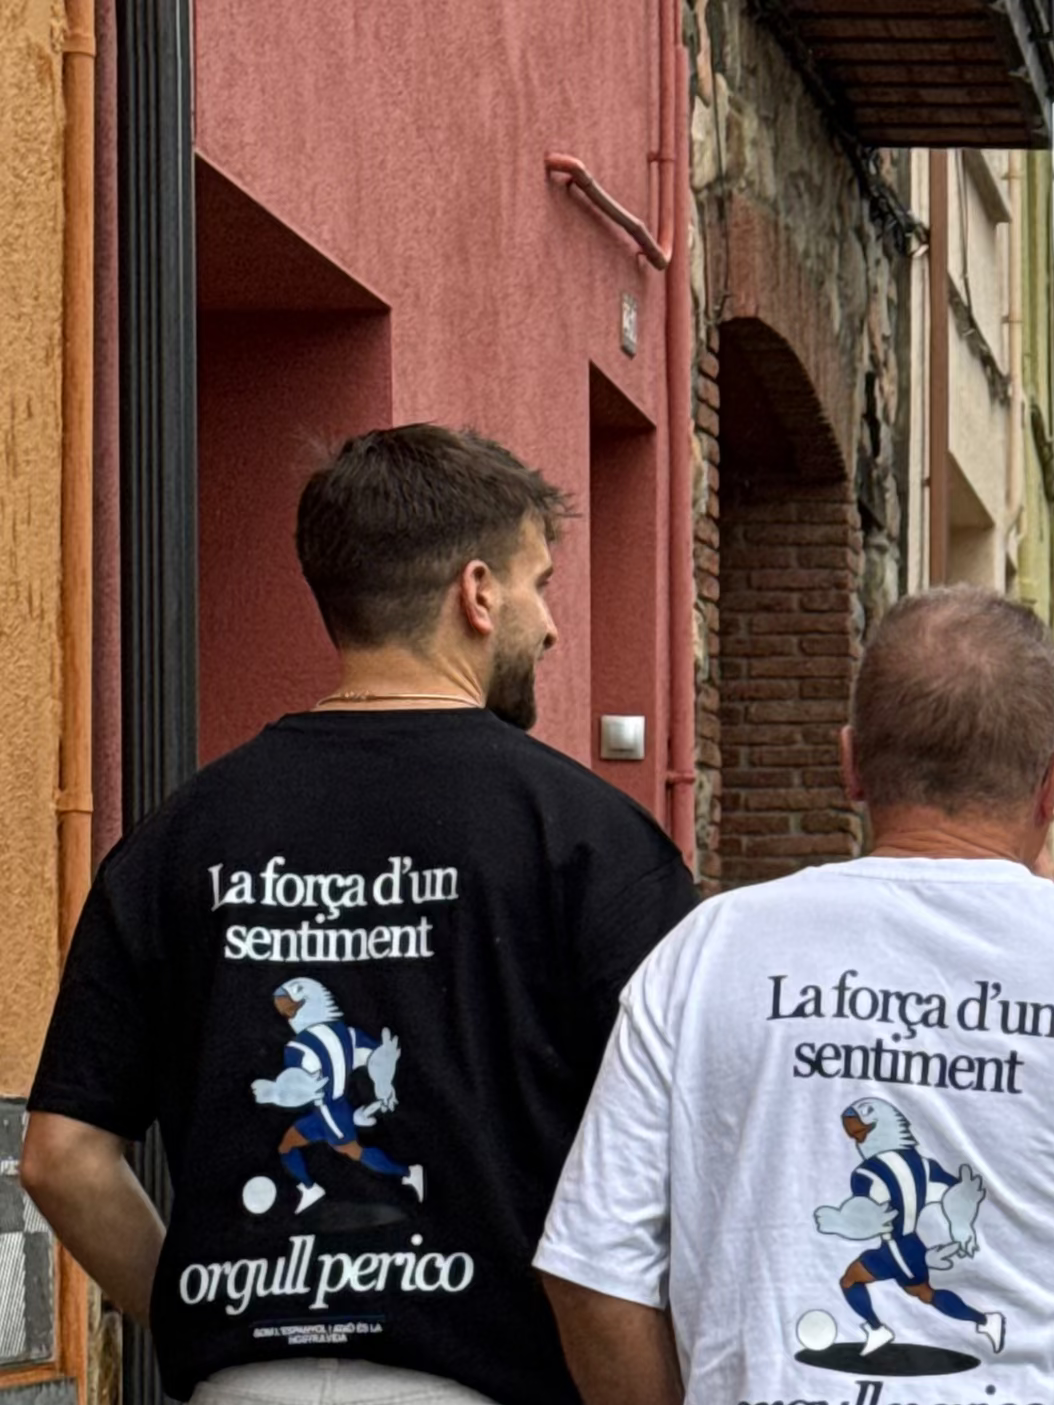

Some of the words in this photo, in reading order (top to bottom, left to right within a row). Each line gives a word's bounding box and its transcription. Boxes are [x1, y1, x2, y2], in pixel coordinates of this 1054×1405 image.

[208, 863, 256, 911] La
[259, 856, 368, 919] força
[373, 856, 460, 906] d'un
[224, 913, 435, 962] sentiment
[766, 975, 826, 1021] La
[832, 969, 950, 1039] força
[793, 1033, 1025, 1094] sentiment
[179, 1235, 315, 1315] orgull
[309, 1233, 474, 1309] perico
